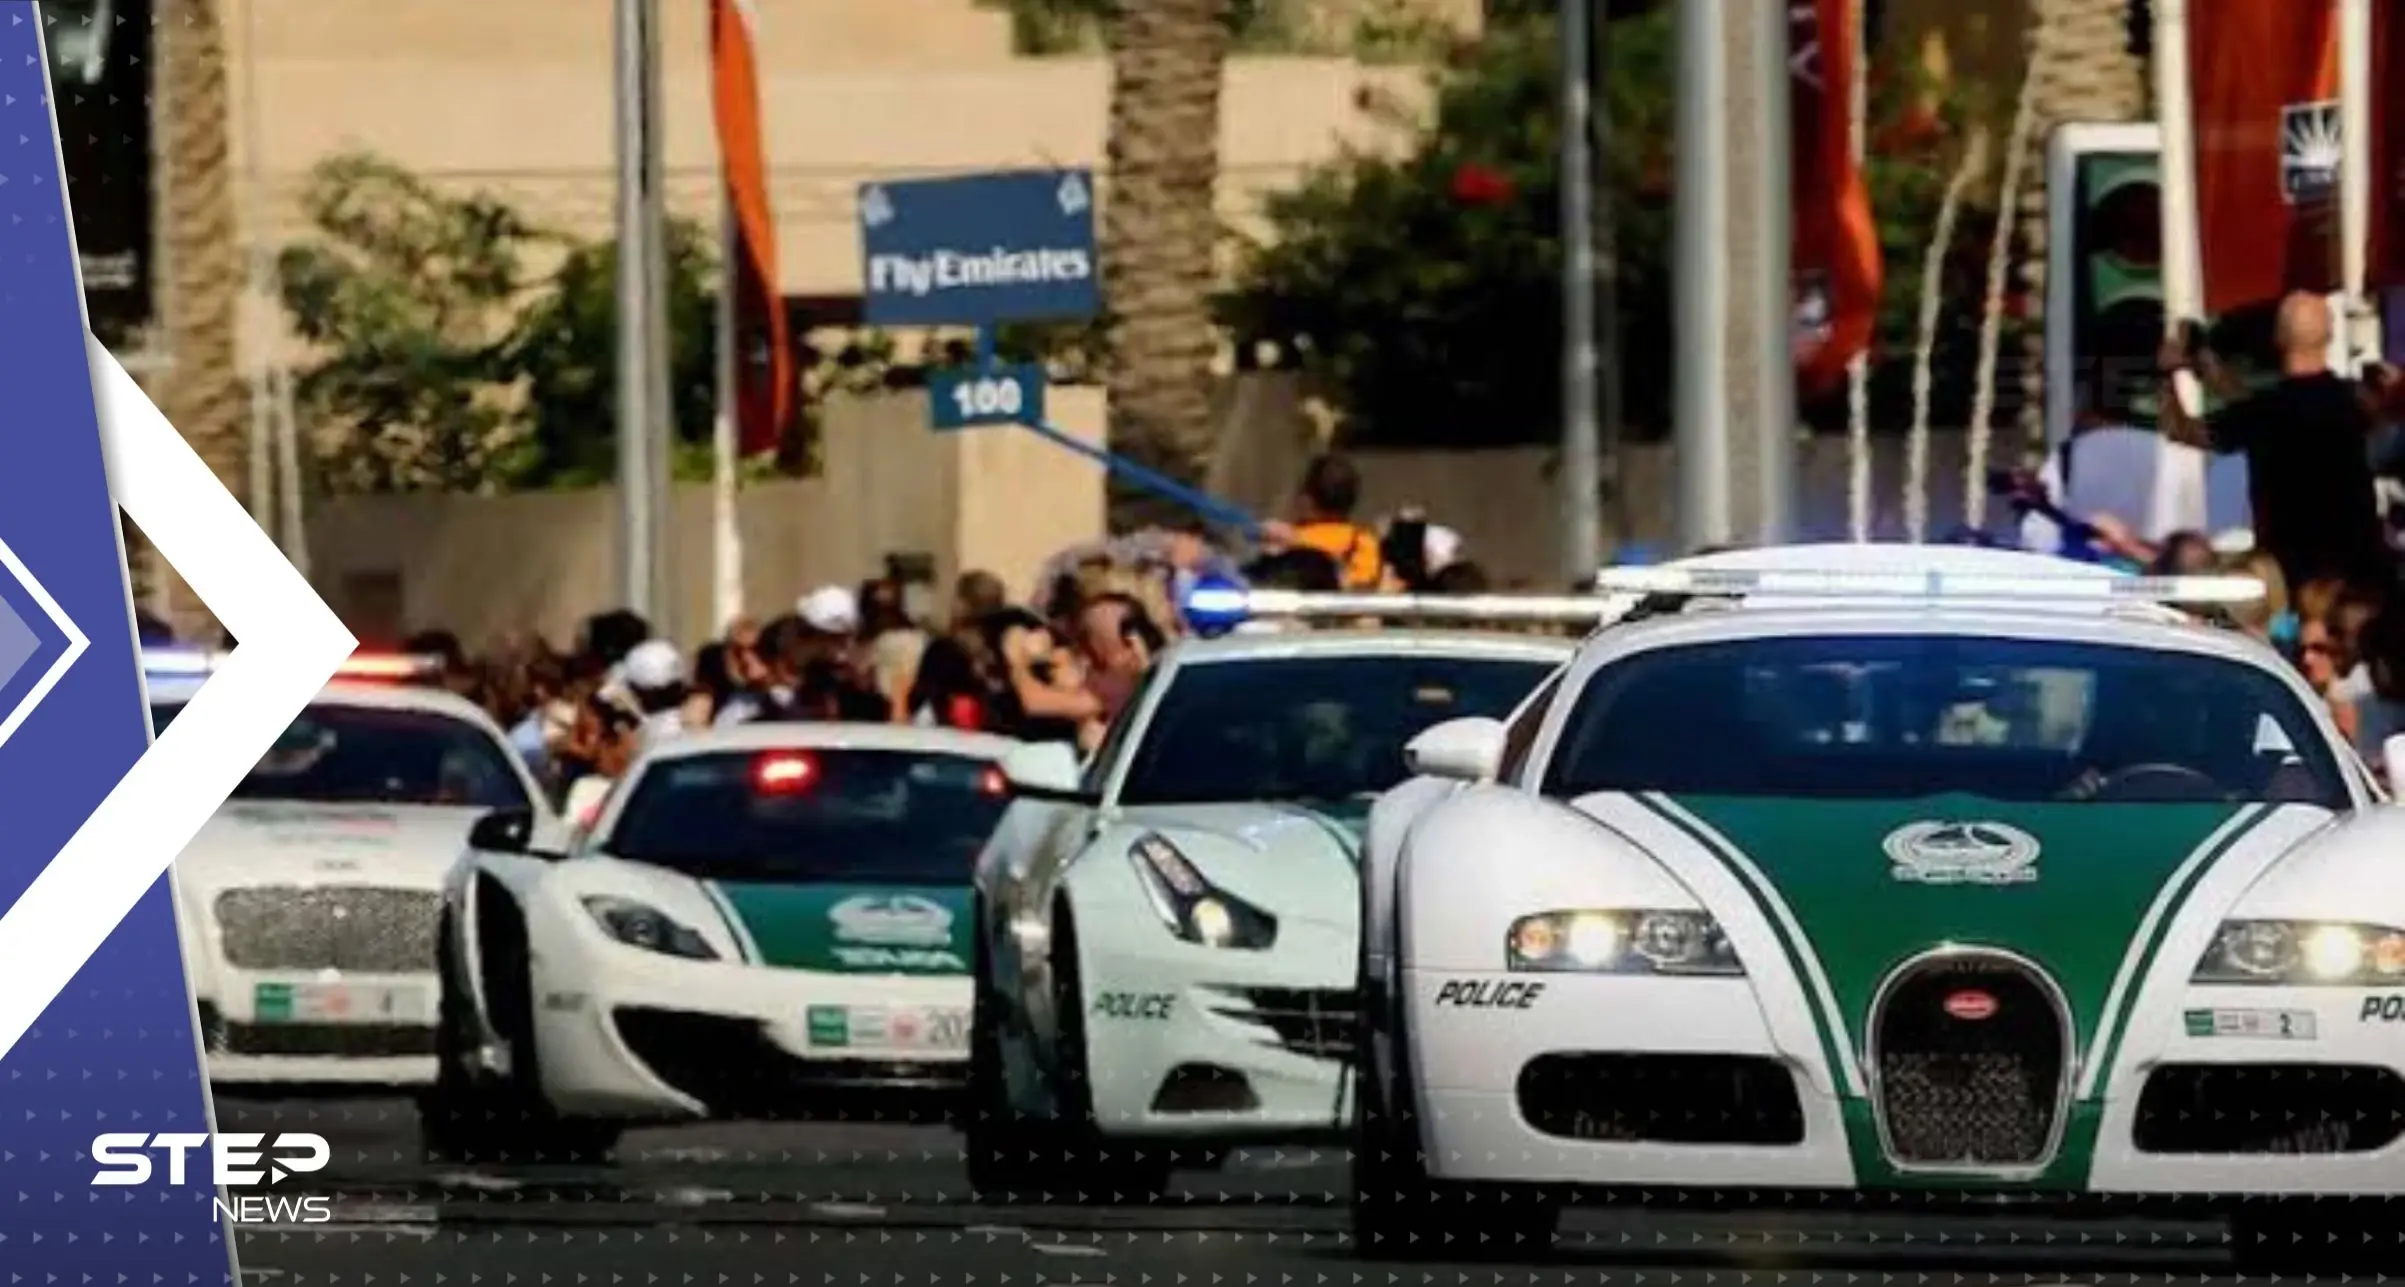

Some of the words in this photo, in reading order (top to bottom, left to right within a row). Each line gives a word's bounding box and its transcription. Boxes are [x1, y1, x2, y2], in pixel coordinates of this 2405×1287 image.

[933, 246, 1091, 287] Emirates
[952, 377, 1022, 417] 100
[1091, 991, 1177, 1020] POLICE
[1436, 979, 1546, 1009] POLICE
